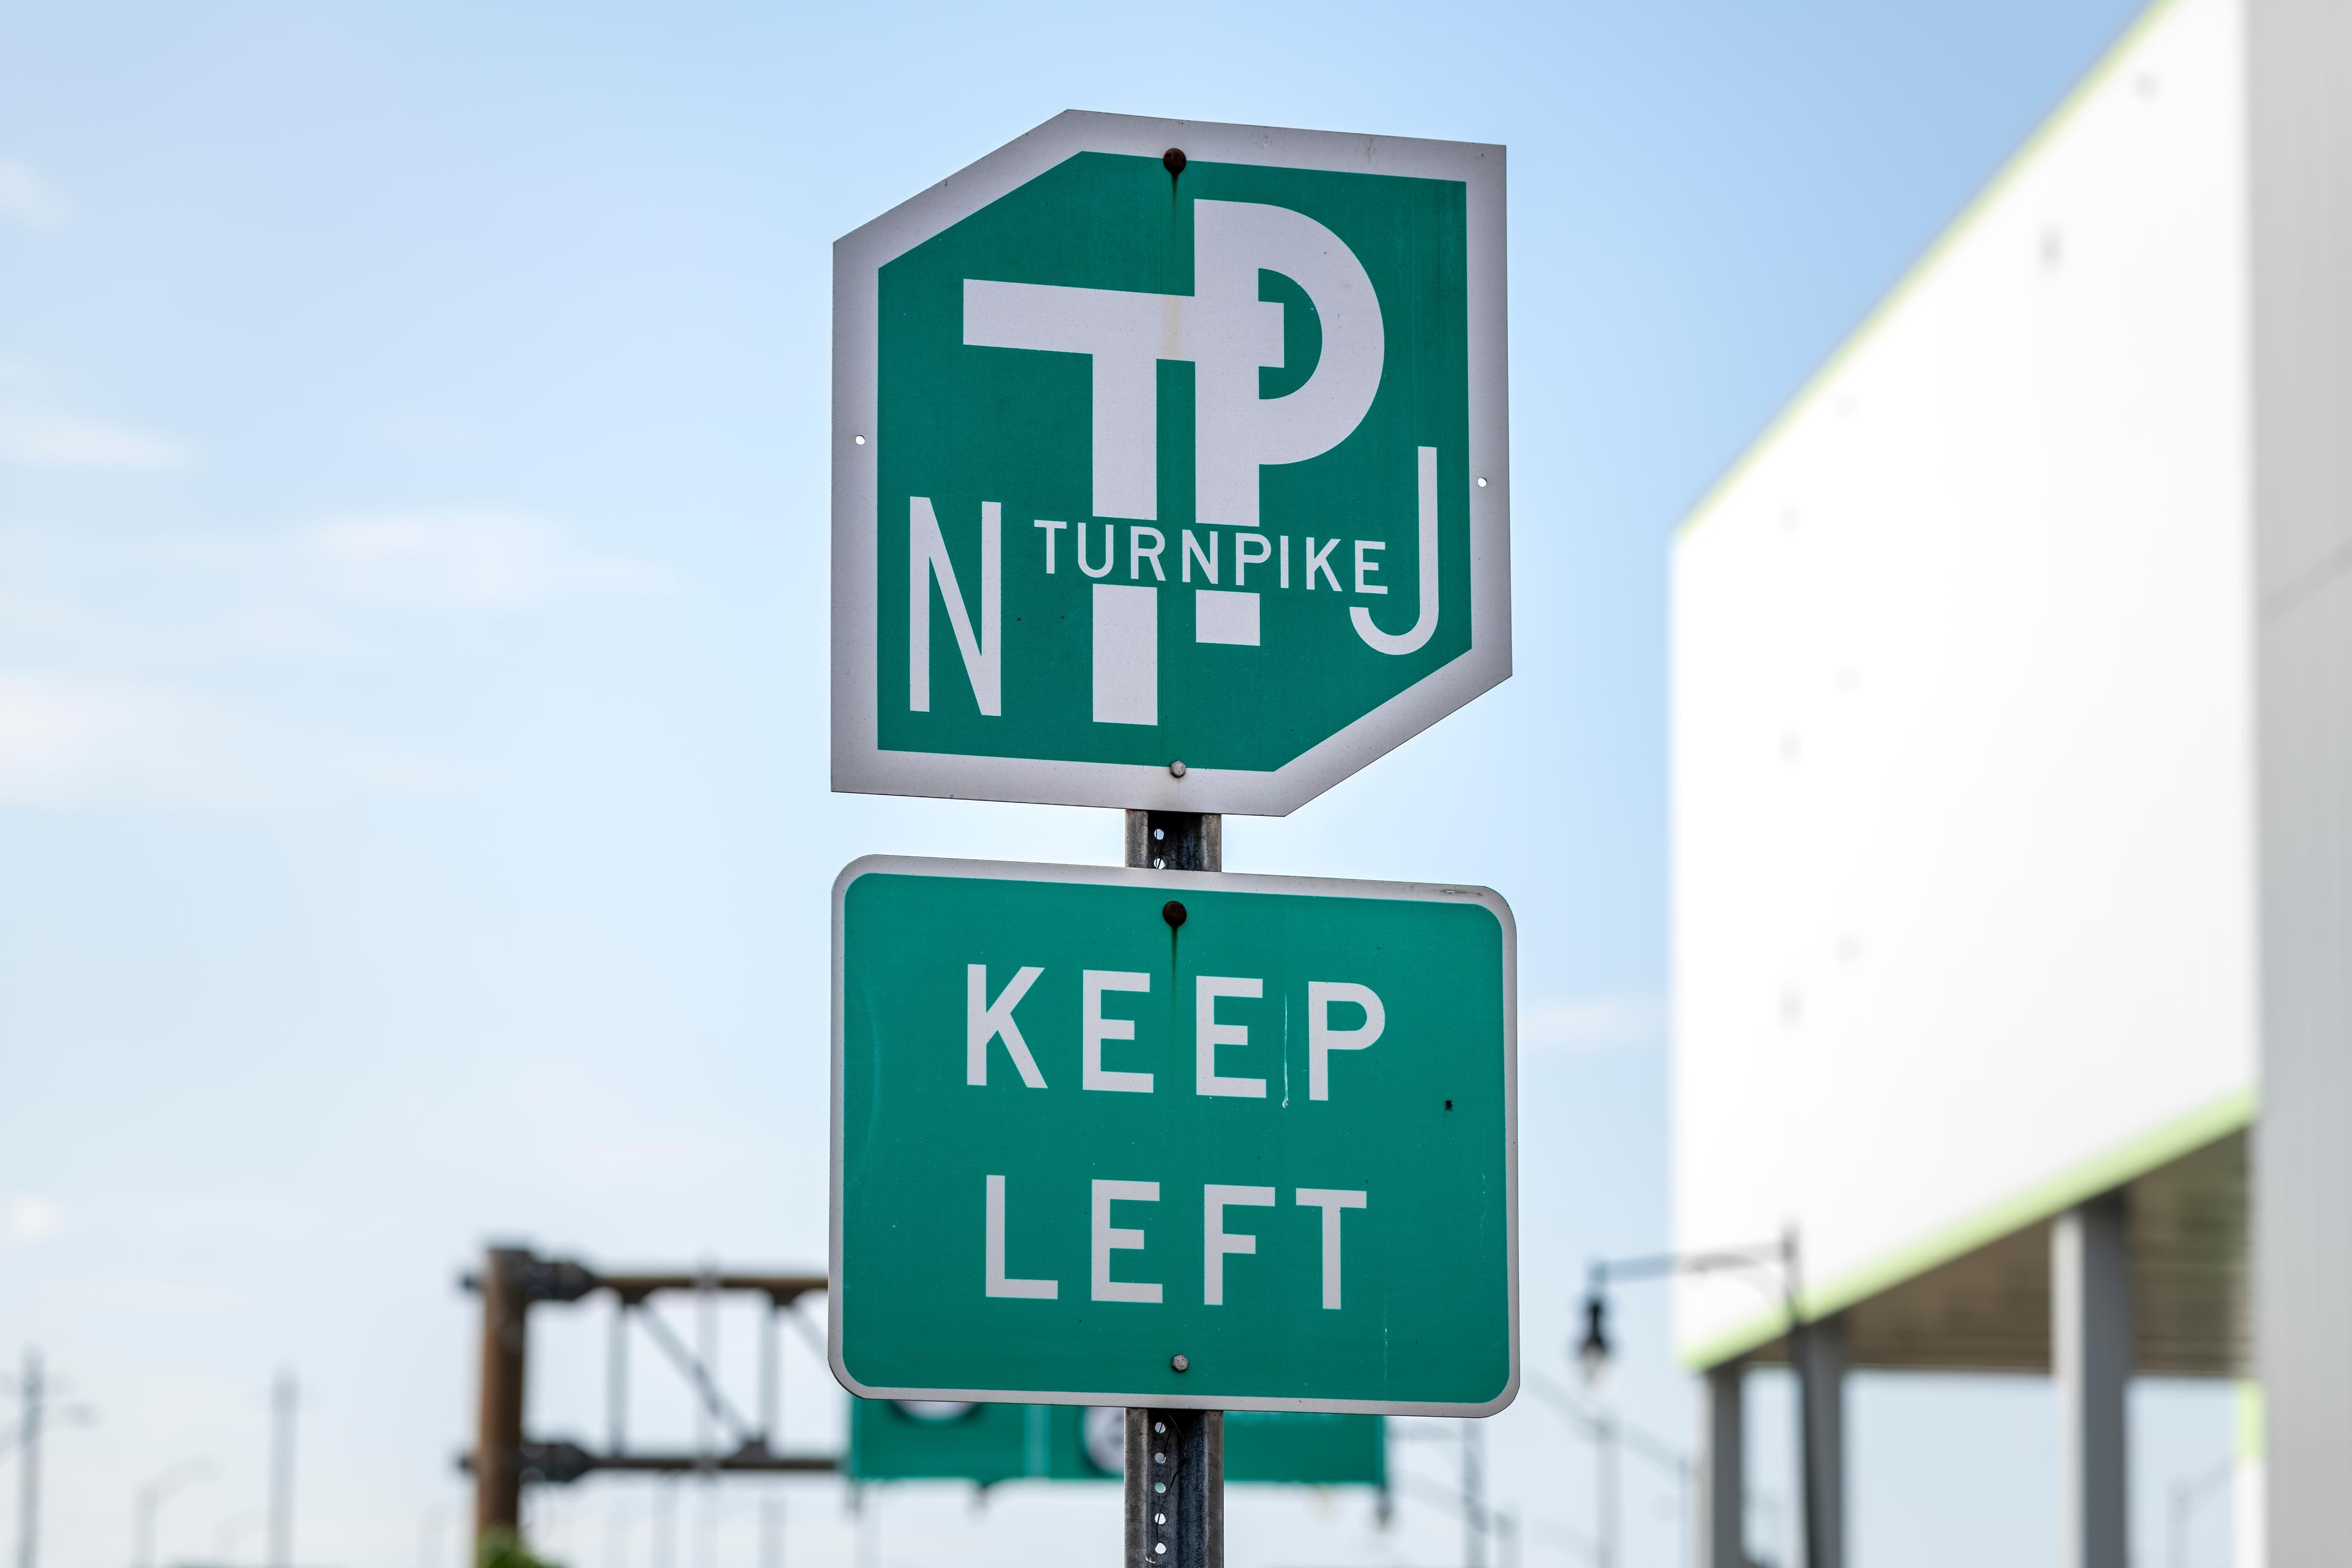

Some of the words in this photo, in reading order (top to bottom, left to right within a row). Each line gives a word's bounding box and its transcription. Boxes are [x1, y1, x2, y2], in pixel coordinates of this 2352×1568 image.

[963, 198, 1385, 726] TP
[910, 496, 1001, 717] N
[1033, 518, 1389, 595] TURNPIKE
[1349, 446, 1439, 655] J
[967, 963, 1385, 1101] KEEP
[986, 1175, 1367, 1310] LEFT
